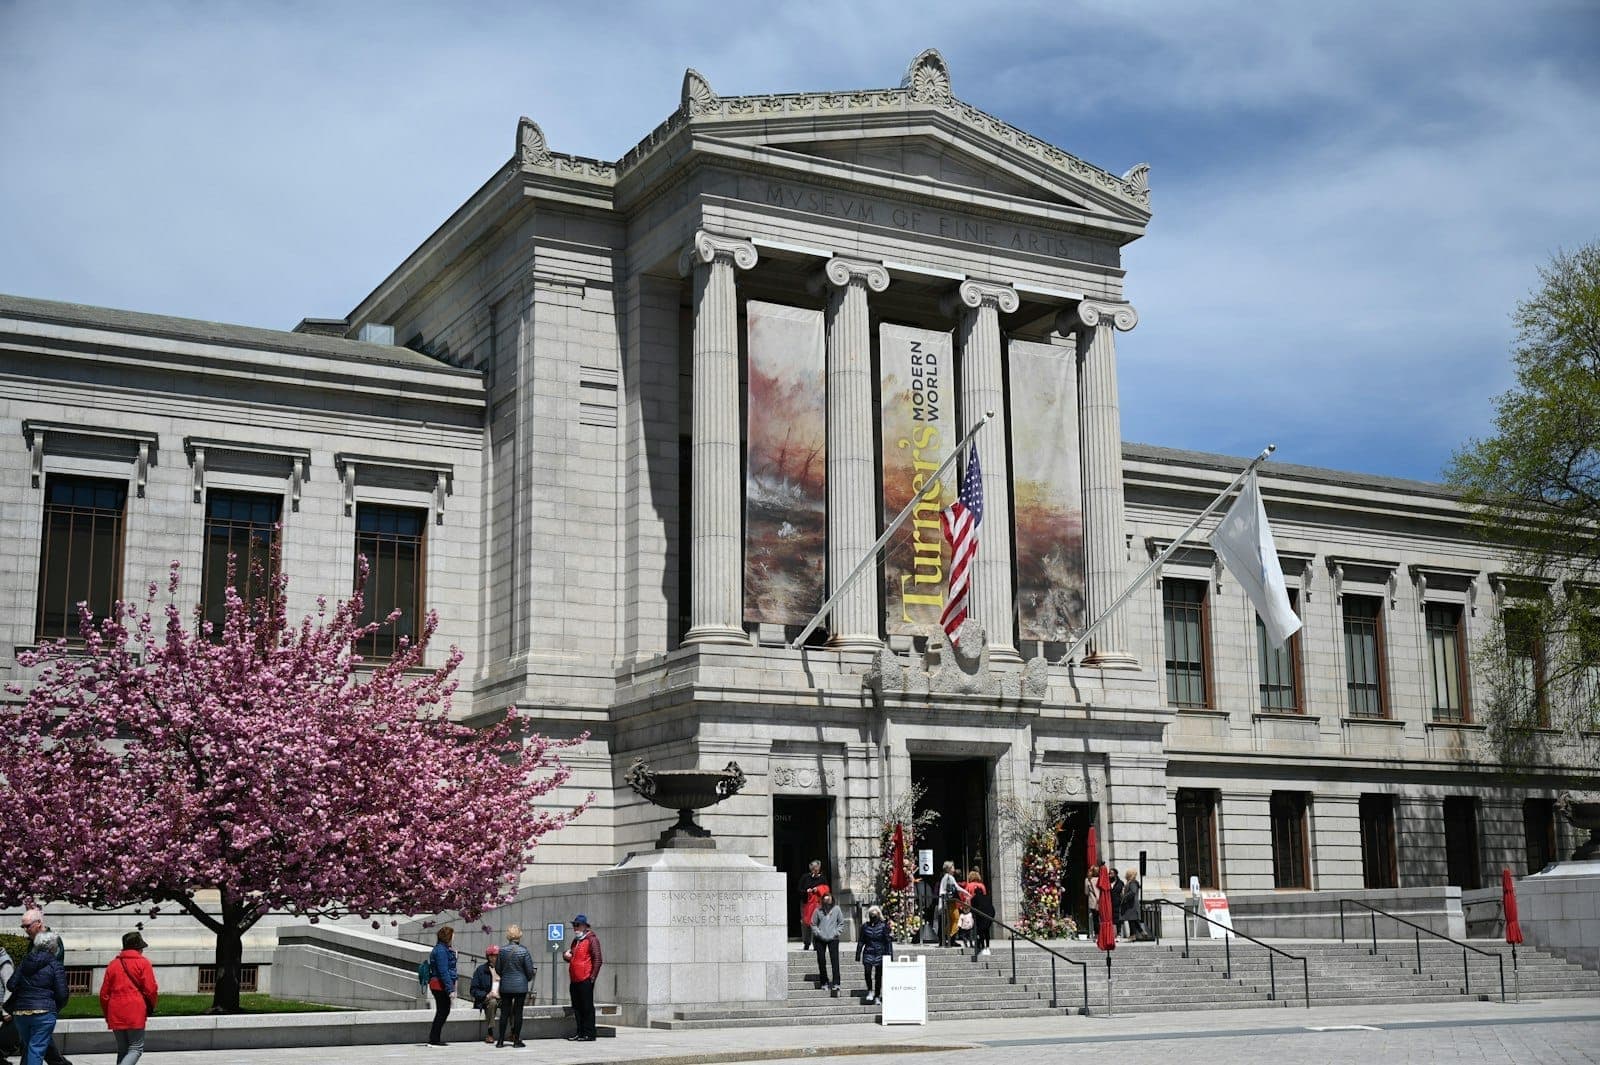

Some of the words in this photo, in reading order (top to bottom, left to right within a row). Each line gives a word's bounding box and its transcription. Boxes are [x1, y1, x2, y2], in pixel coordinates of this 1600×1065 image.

[892, 208, 922, 230] OF
[939, 217, 994, 245] FINE
[1010, 232, 1069, 257] ARTS
[910, 341, 923, 421] MODERN
[925, 353, 939, 422] WORLD
[896, 425, 945, 623] Turner's
[661, 892, 688, 901] BANK
[689, 892, 702, 901] OF
[705, 892, 744, 901] AMERICA
[671, 915, 706, 924] AVENUE
[708, 915, 721, 924] OF
[724, 915, 741, 924] THE
[744, 915, 768, 924] ARTS
[701, 904, 716, 912] ON
[719, 904, 737, 912] THE
